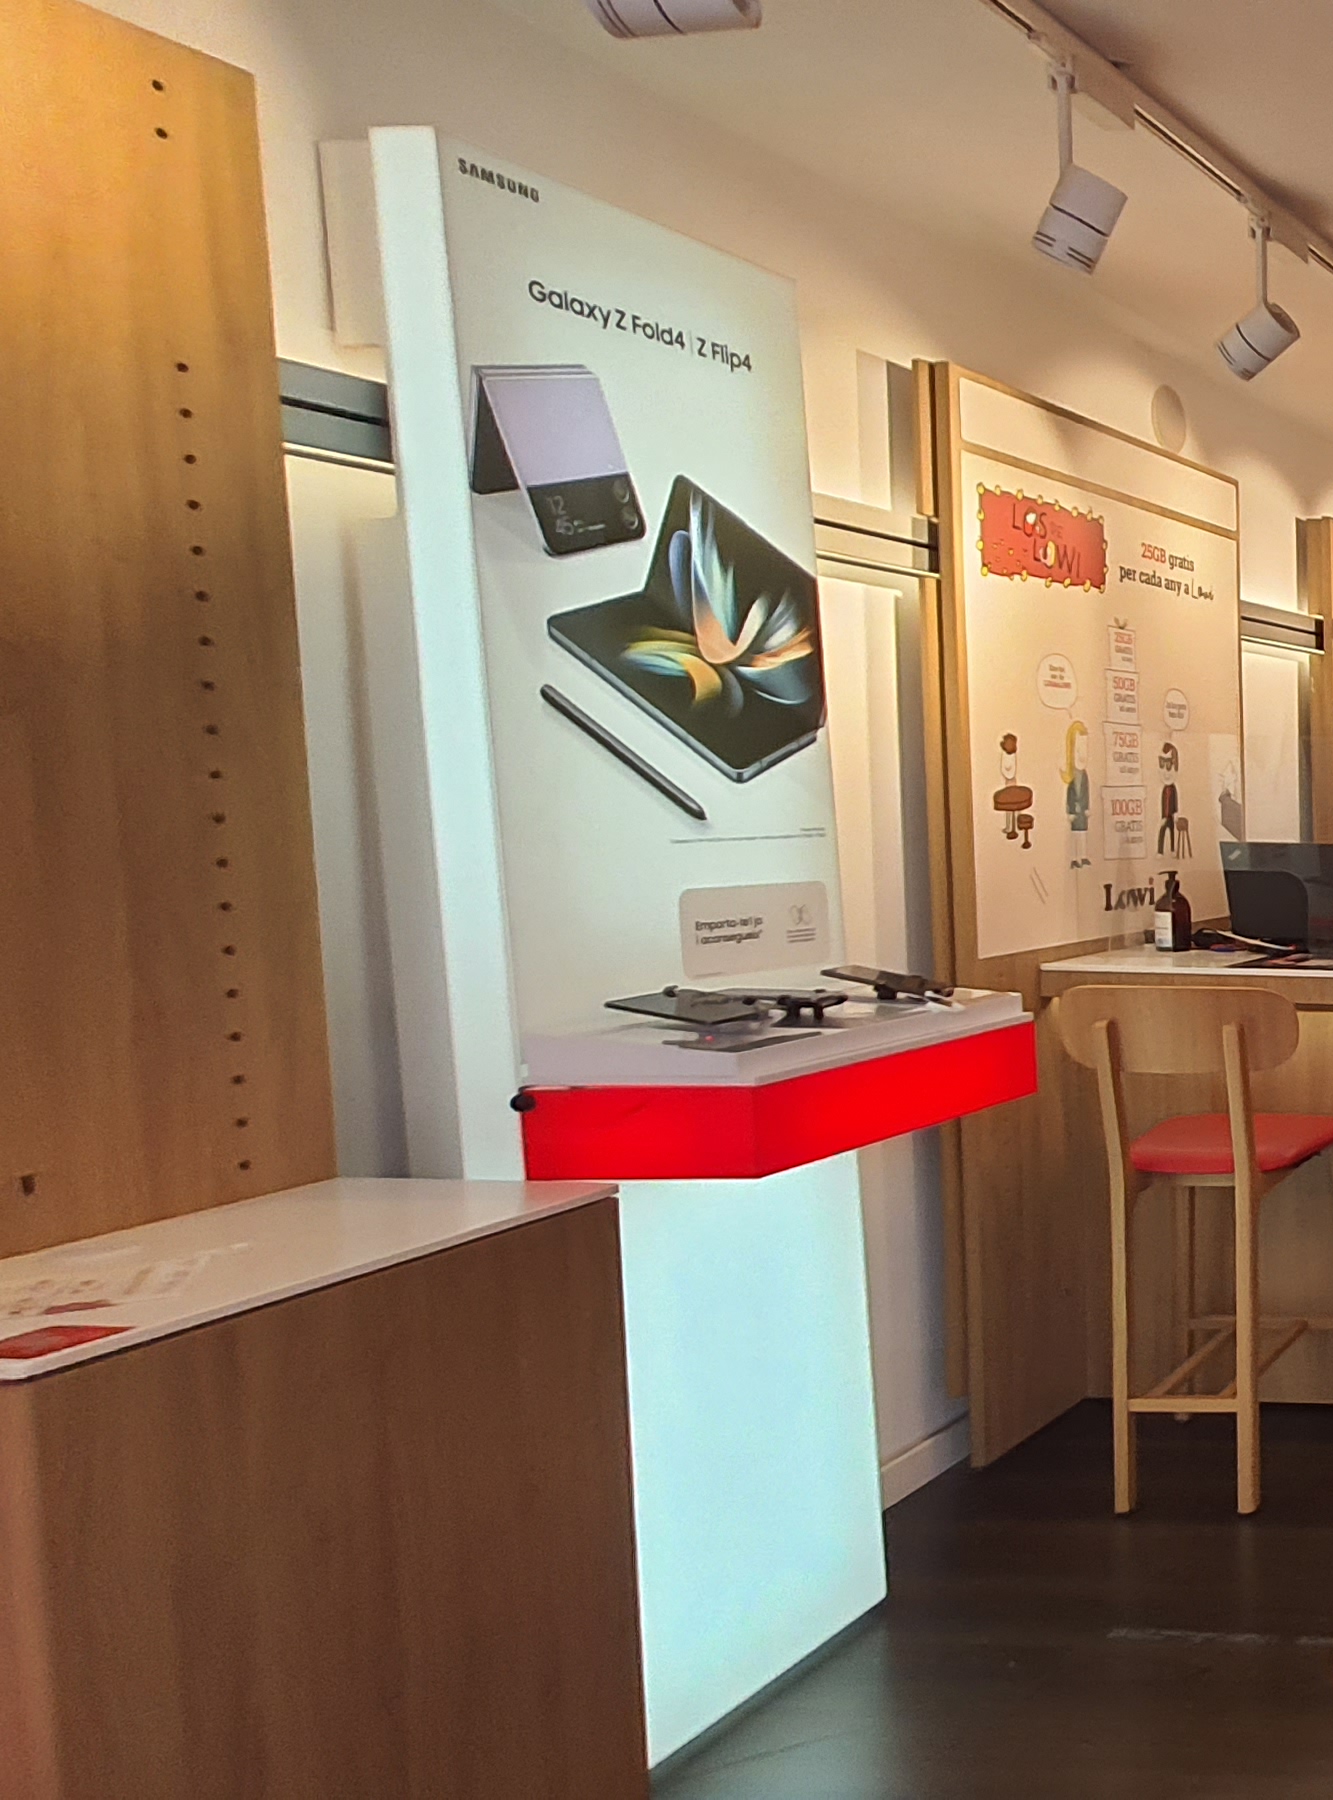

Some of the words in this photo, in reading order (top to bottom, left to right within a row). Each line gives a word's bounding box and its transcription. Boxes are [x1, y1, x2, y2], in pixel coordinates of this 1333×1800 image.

[457, 157, 540, 203] SAMSUNG
[528, 279, 612, 330] Galaxy
[614, 308, 627, 332] Z
[631, 313, 686, 350] Fold4
[696, 336, 708, 359] Z
[711, 341, 752, 374] Flip4
[1140, 542, 1167, 565] 25GB
[1168, 553, 1195, 573] gratis
[1119, 564, 1138, 583] per
[1138, 569, 1162, 589] cada
[1163, 580, 1183, 597] any
[1183, 583, 1190, 596] a
